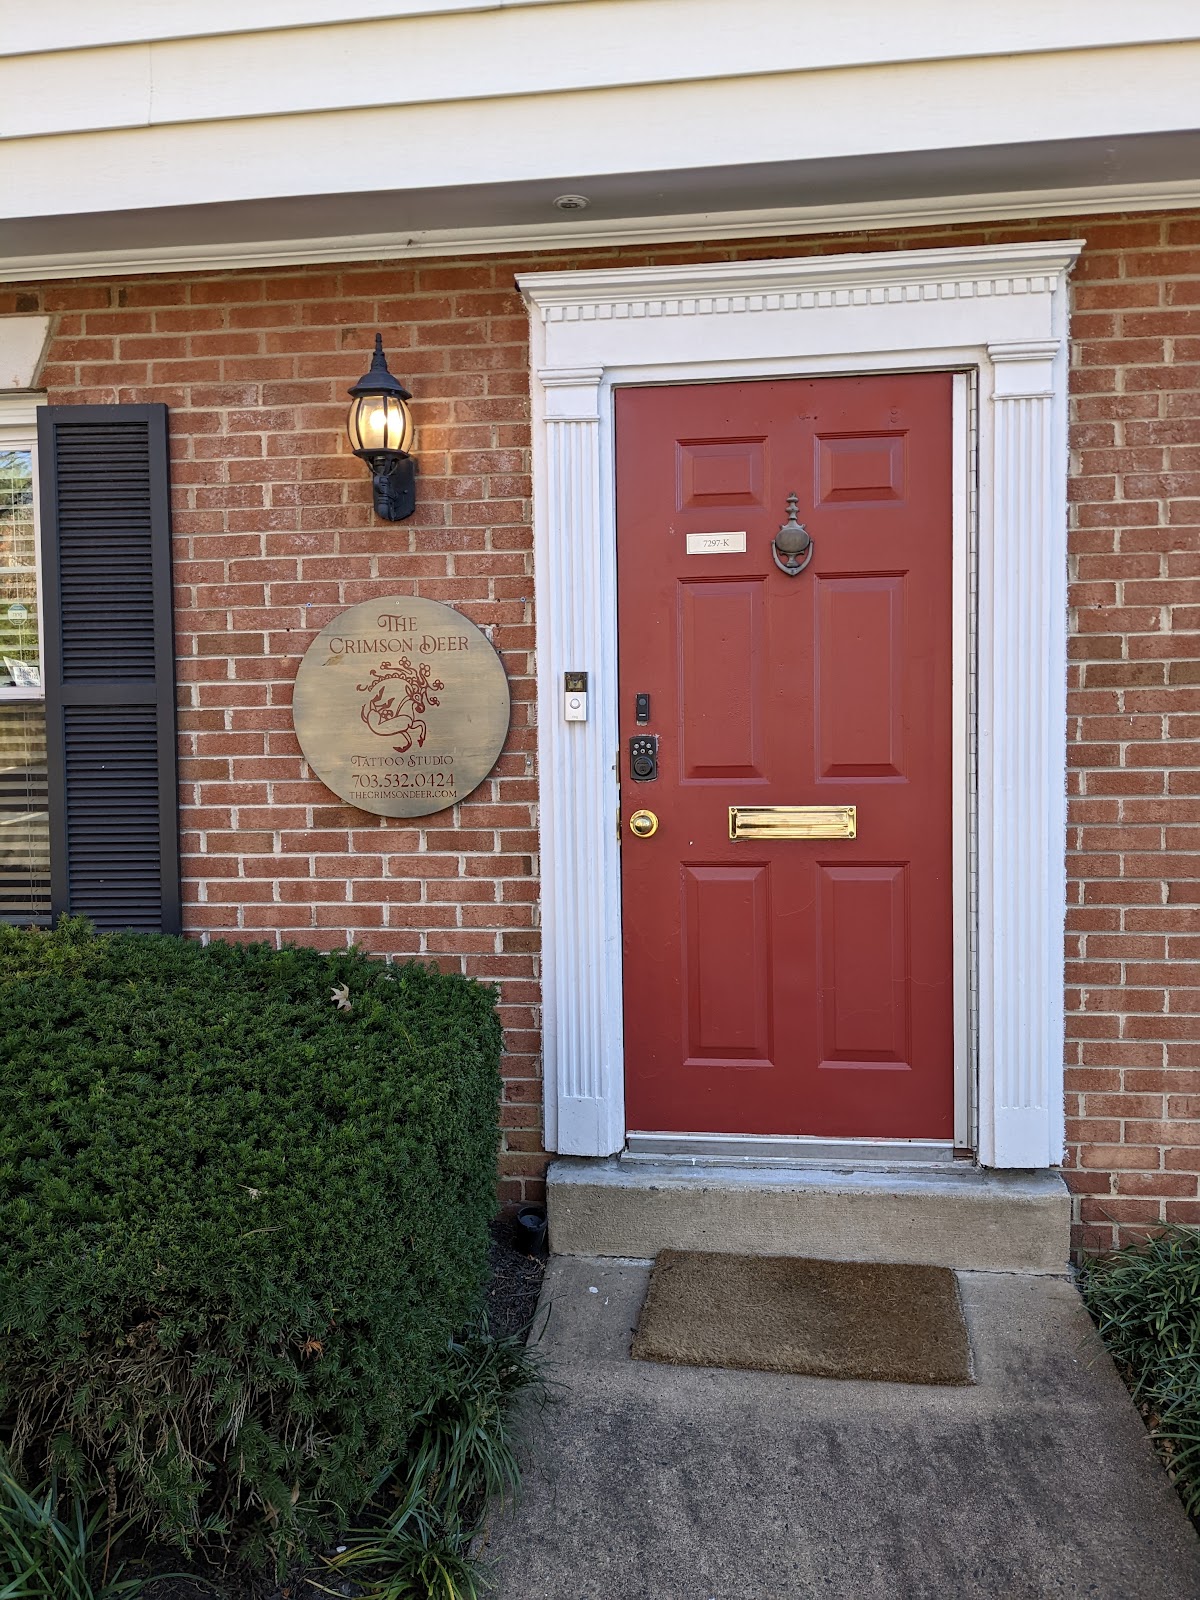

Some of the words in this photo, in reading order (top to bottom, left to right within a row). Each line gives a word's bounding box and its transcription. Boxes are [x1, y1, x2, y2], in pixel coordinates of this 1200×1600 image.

[703, 538, 730, 548] 7297-K
[377, 614, 418, 632] THE
[329, 637, 413, 654] CRIMSON
[419, 634, 469, 655] DEER
[350, 755, 405, 767] TATTOO
[407, 754, 454, 768] STUDIO
[351, 773, 456, 788] 703.532.0424
[349, 790, 457, 800] THECRIMSONDEER.COM
